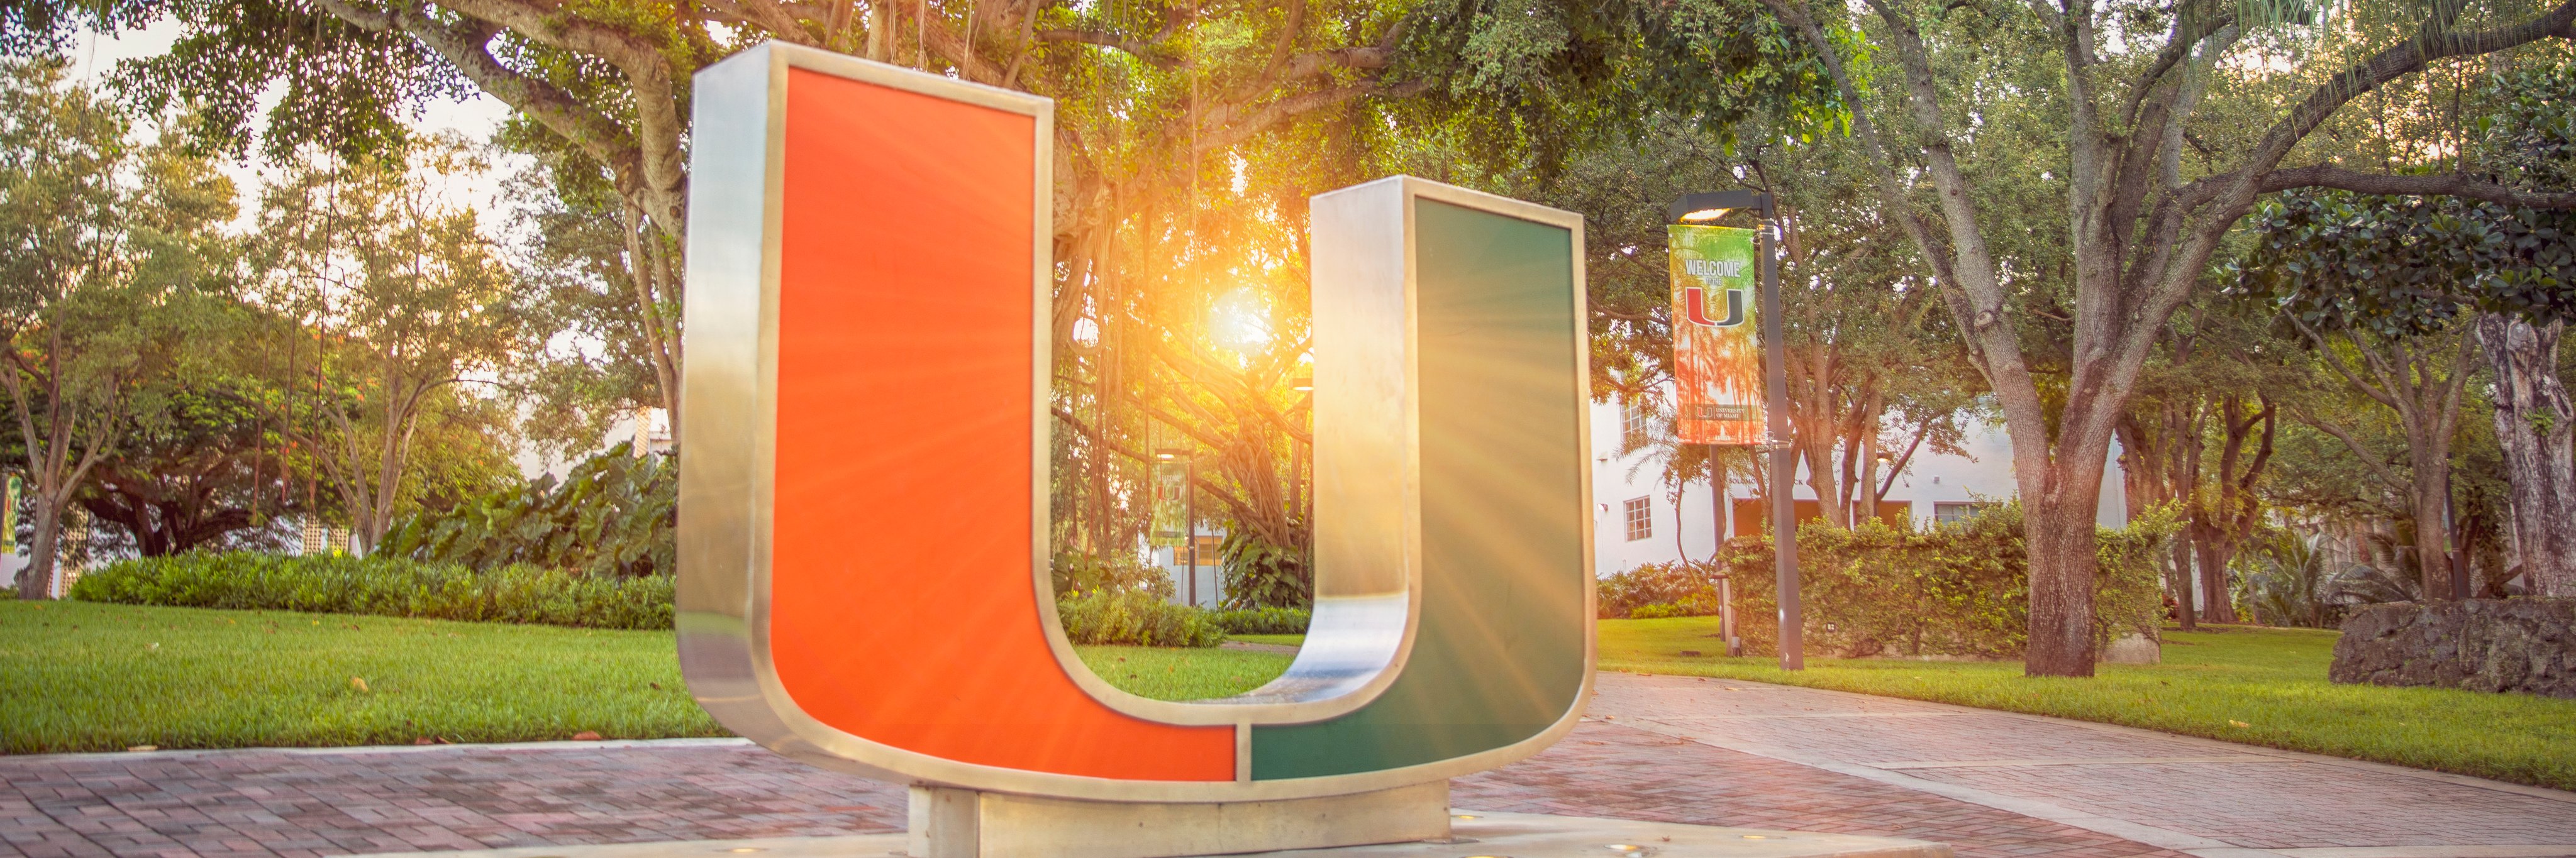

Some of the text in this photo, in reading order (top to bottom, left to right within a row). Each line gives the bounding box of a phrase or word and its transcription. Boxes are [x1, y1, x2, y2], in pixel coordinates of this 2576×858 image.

[1685, 260, 1741, 278] WELCOME
[1685, 287, 1744, 327] U
[1697, 407, 1712, 417] U
[676, 41, 1596, 803] U
[1157, 485, 1180, 501] U
